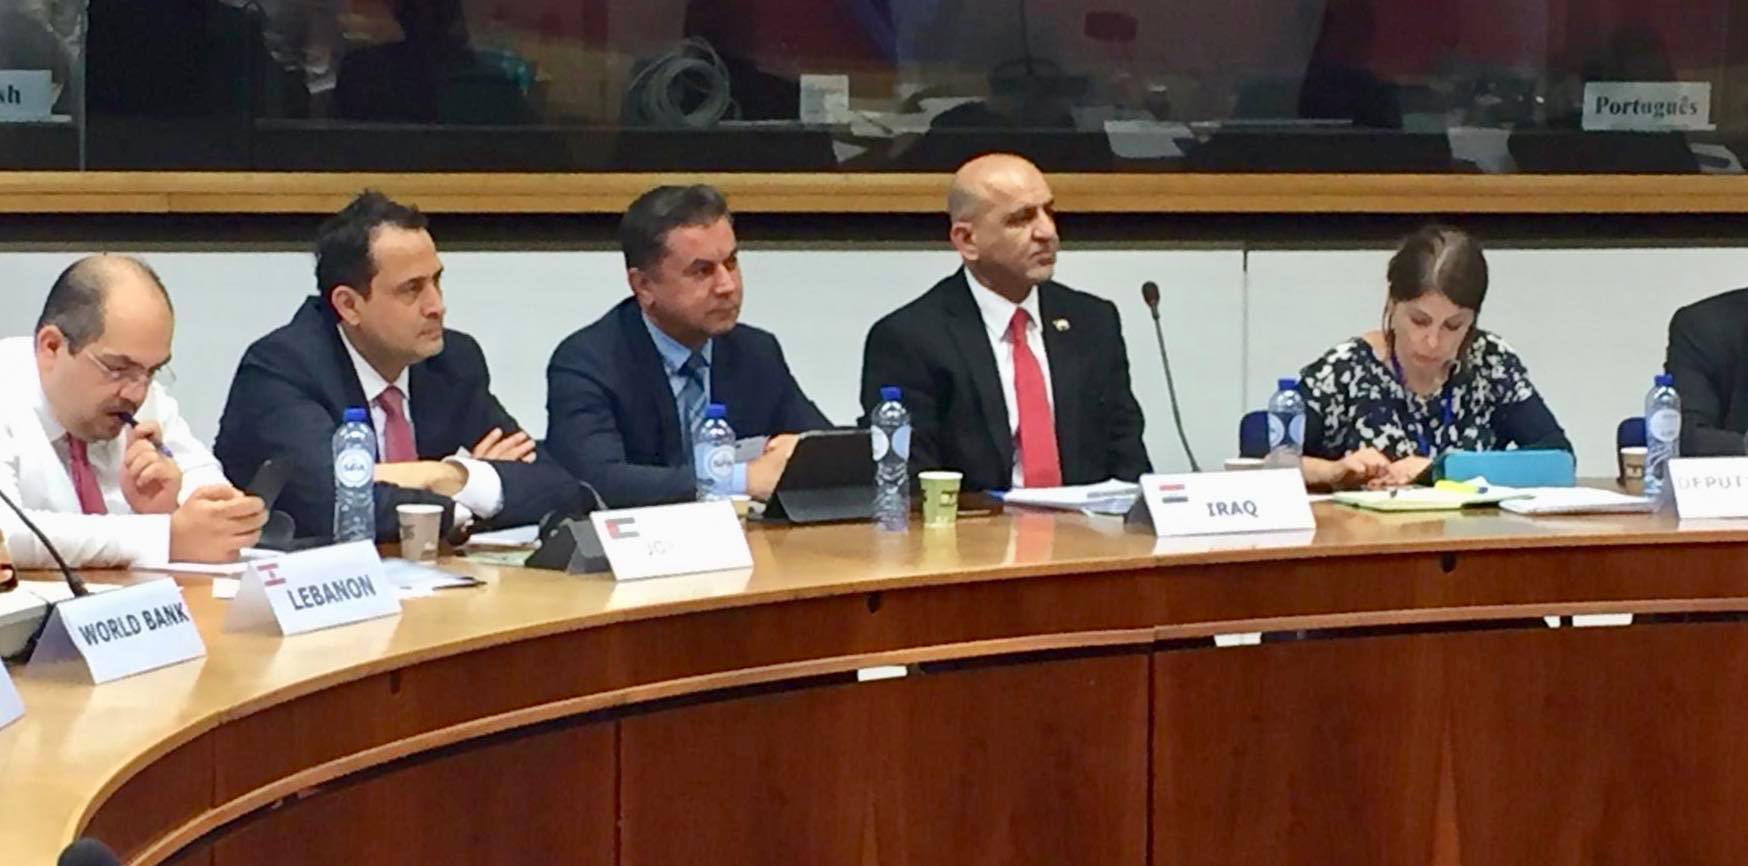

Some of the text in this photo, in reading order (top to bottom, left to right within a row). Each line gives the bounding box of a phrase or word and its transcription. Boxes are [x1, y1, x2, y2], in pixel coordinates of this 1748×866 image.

[1595, 96, 1698, 118] Português
[1207, 500, 1258, 518] IRAQ
[286, 574, 377, 611] LEBANON
[78, 602, 190, 646] WORLD BANK
